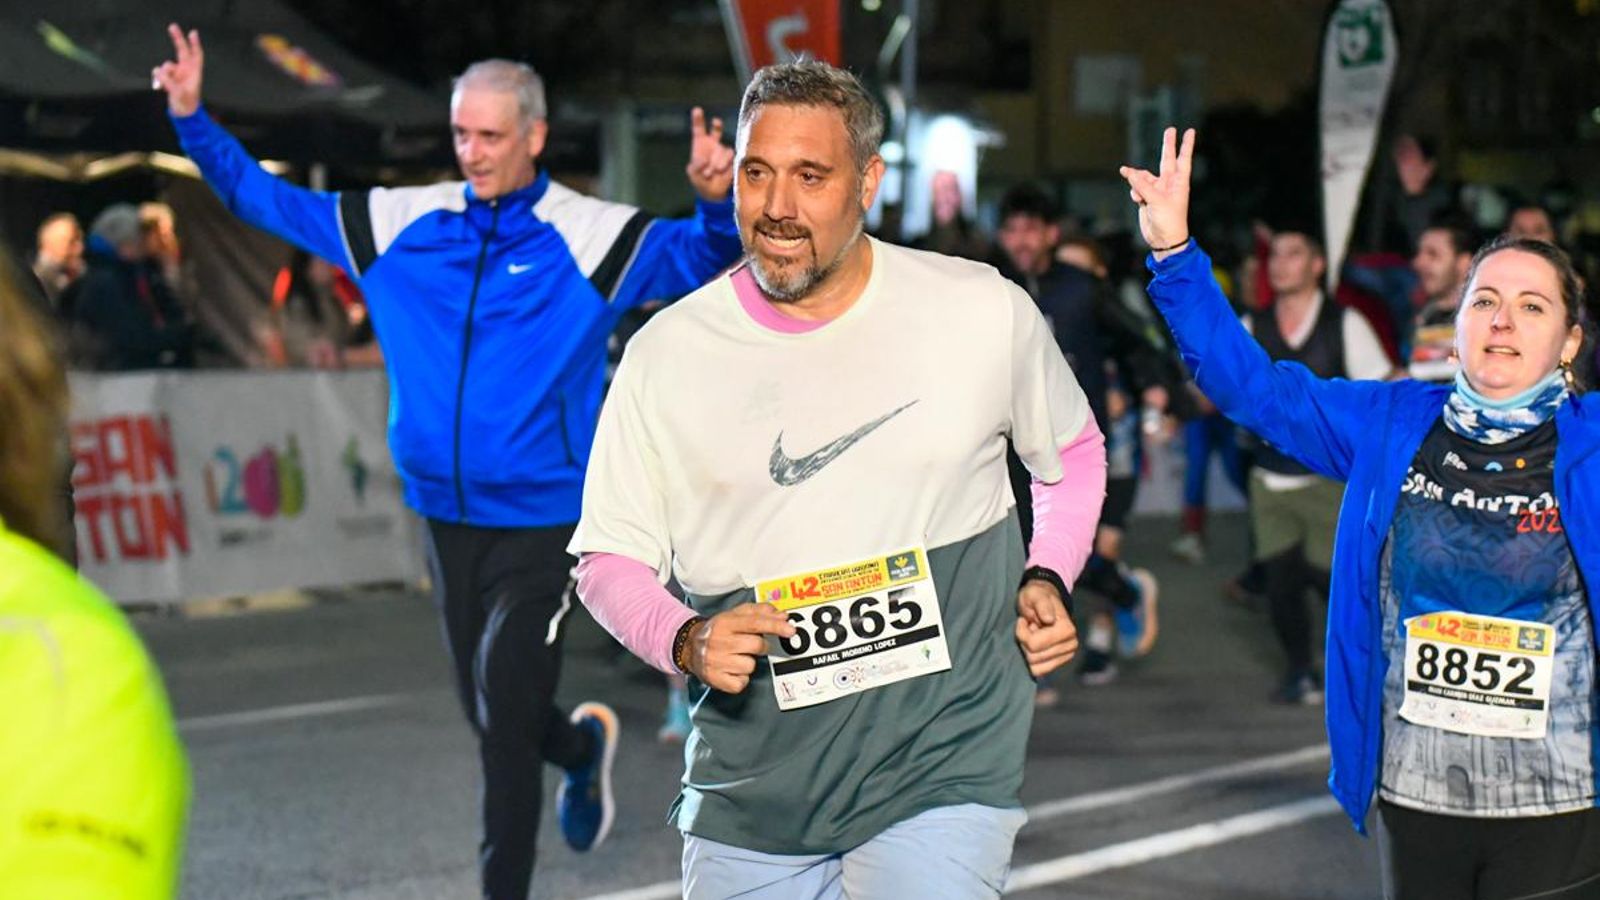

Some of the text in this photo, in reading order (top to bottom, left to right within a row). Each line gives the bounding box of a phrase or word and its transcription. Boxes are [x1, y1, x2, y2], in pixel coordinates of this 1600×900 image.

[69, 413, 177, 486] SAN
[1451, 488, 1559, 516] ANTO
[73, 490, 191, 564] TON
[1516, 508, 1563, 533] 202
[790, 577, 821, 600] 42
[778, 586, 923, 656] 6865
[1436, 616, 1461, 638] 42
[813, 638, 896, 665] RAFAEL MORENO LOPEZ
[1416, 643, 1536, 695] 8852
